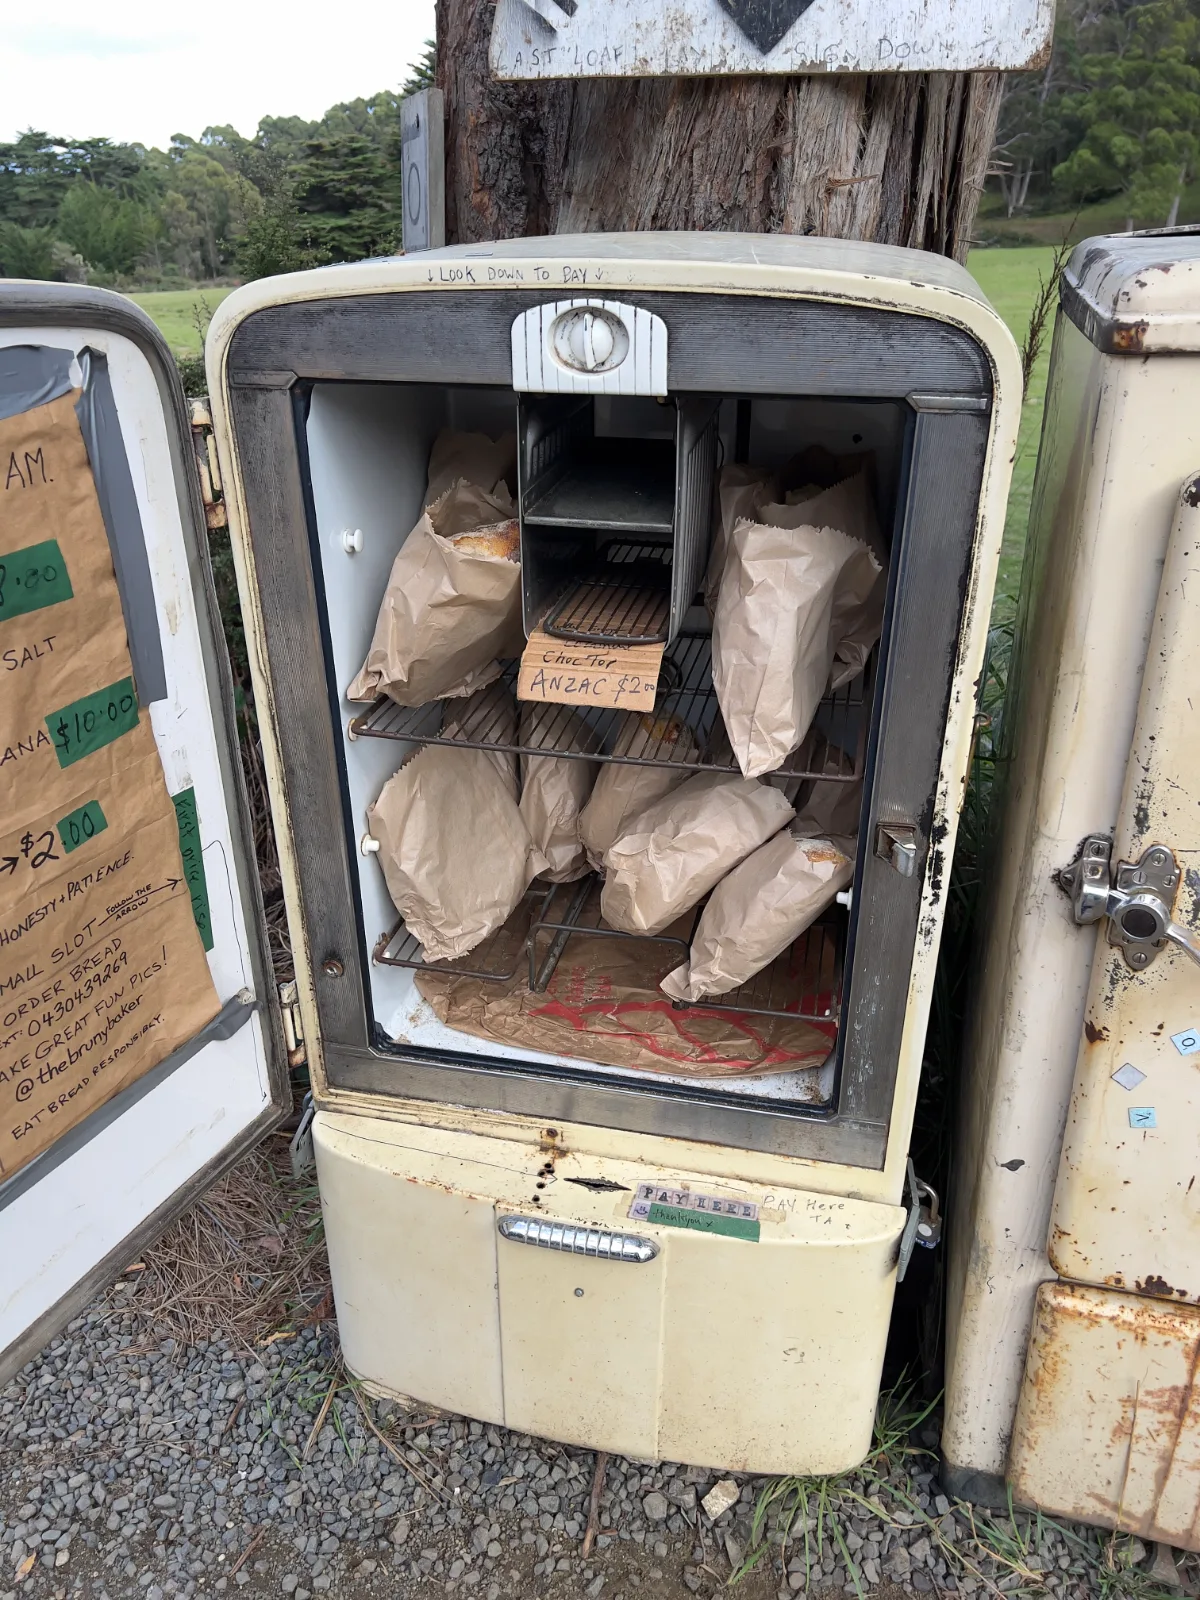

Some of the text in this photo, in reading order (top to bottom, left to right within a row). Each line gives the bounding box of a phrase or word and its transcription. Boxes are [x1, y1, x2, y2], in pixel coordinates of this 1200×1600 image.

[495, 47, 556, 70] LAST
[574, 43, 623, 67] LOAF
[878, 38, 954, 60] DOWN
[440, 266, 588, 283] LOOK DOWN TO PAY
[5, 447, 54, 490] AM.
[3, 635, 56, 671] SALT
[530, 669, 607, 698] ANZAC
[0, 694, 133, 766] ANA $10.00
[115, 897, 149, 921] ARROW
[135, 883, 152, 897] THE
[0, 898, 57, 946] HONESTY
[51, 918, 97, 964] SLOT
[3, 937, 122, 1027] ORDER BREAD
[28, 951, 128, 1037] 0430439269
[35, 1014, 90, 1059] GREAT
[94, 986, 125, 1017] FUN
[130, 945, 168, 989] PICS!
[15, 994, 144, 1102] @thebrunybaker
[11, 1014, 165, 1140] EAT BREAD RESPONSIBLY.
[643, 1187, 751, 1217] PAY HERE
[763, 1195, 845, 1212] PAY Here
